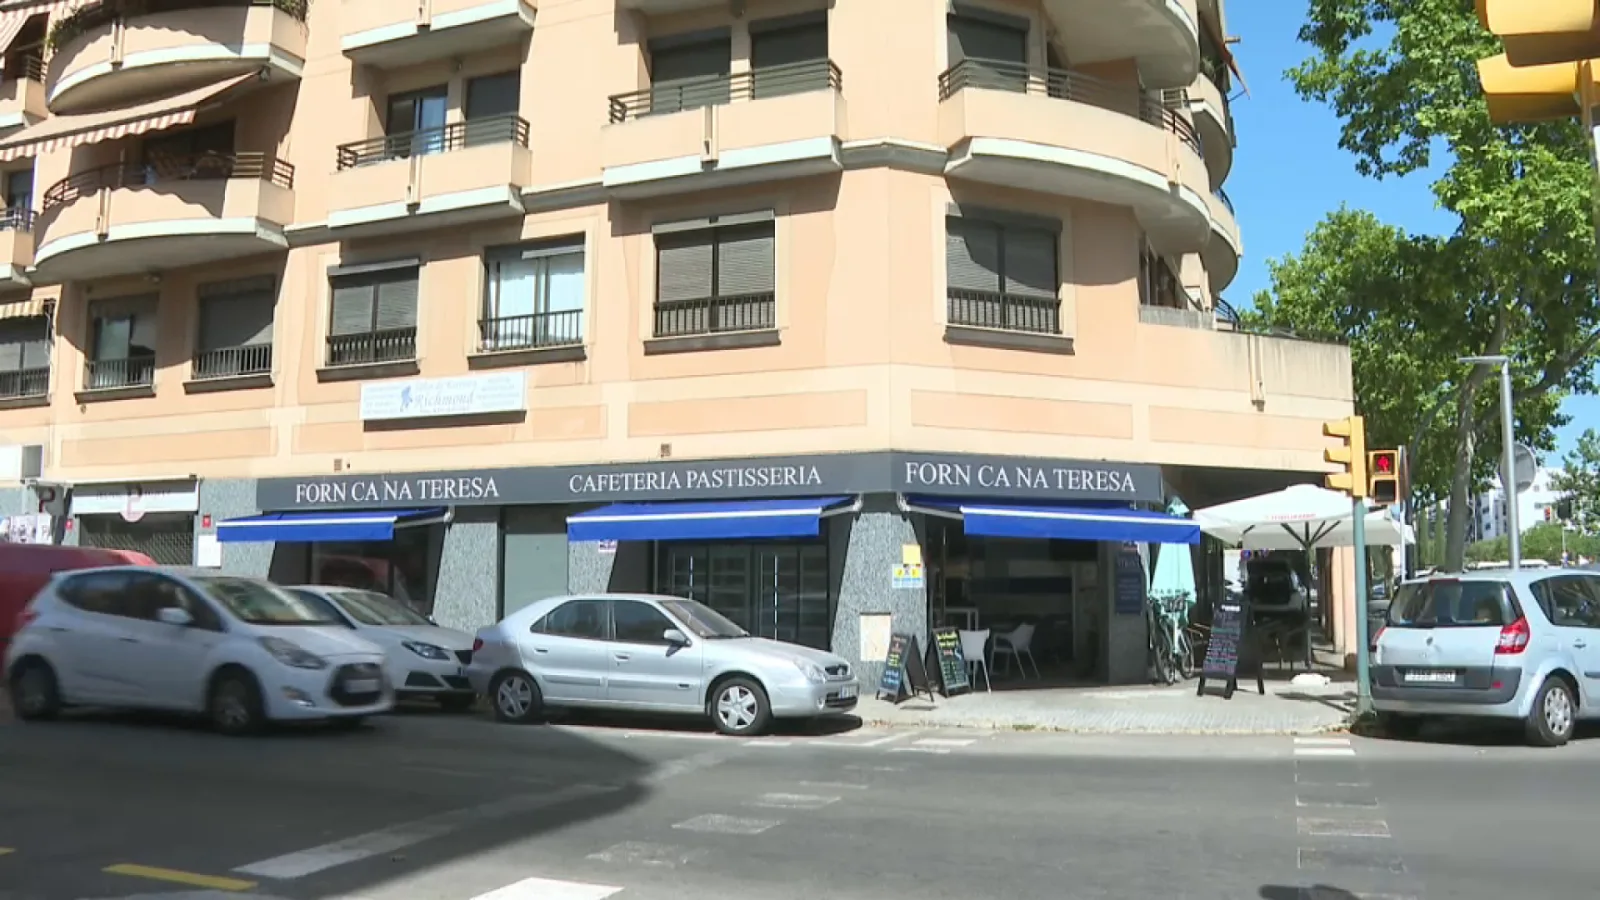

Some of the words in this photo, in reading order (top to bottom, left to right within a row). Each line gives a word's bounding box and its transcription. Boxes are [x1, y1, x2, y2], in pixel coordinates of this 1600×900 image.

[295, 482, 346, 504] FORN
[351, 480, 379, 502] CA
[383, 479, 413, 501] NA
[417, 476, 500, 499] TERESA
[569, 470, 681, 494] CAFETERIA
[686, 465, 823, 489] PASTISSERIA
[904, 461, 971, 487] FORN
[978, 464, 1011, 488] CA
[1016, 466, 1049, 489] NA
[1053, 467, 1136, 493] TERESA
